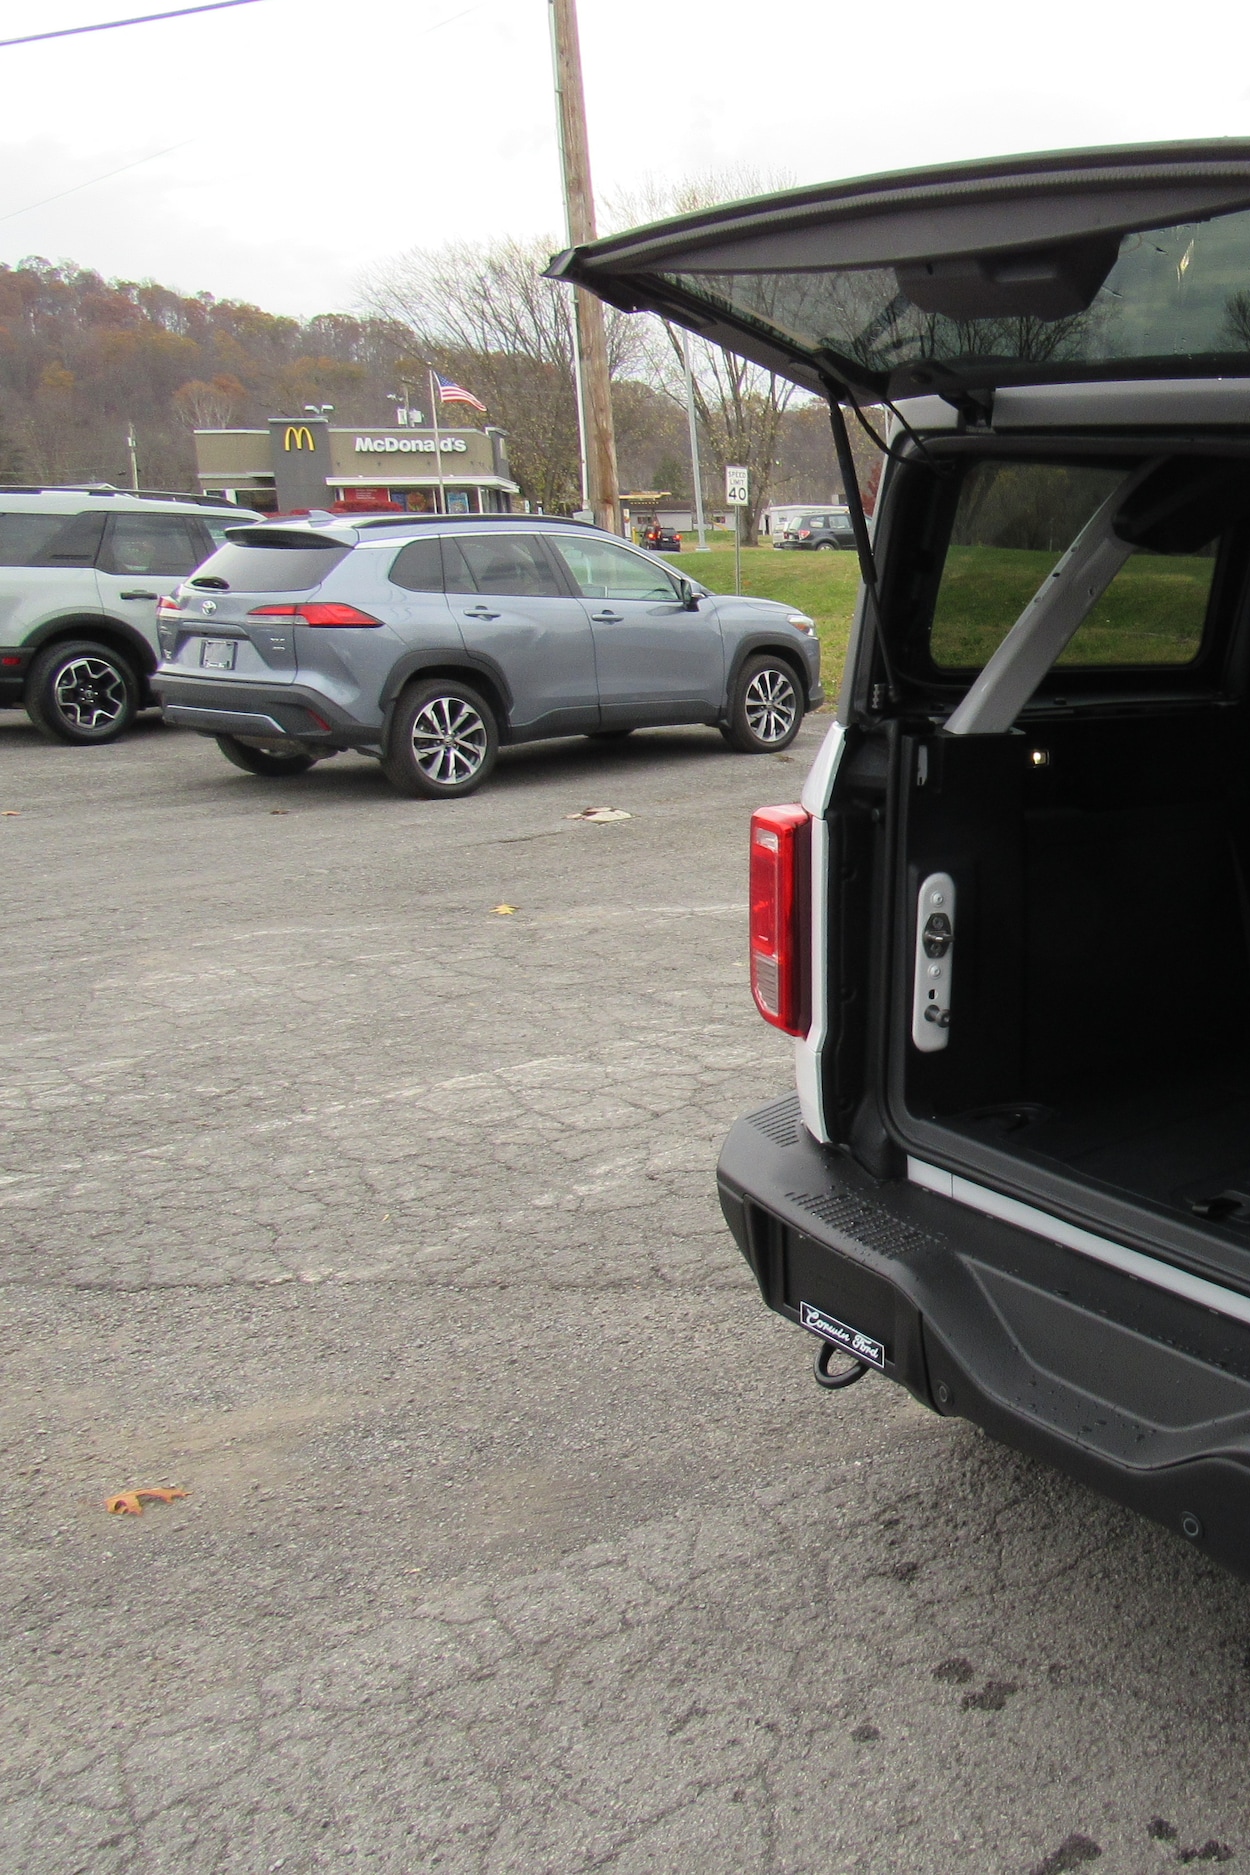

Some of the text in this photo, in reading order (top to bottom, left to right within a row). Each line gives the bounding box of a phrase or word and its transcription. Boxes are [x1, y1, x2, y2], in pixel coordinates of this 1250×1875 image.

[355, 436, 467, 452] McDonad's
[728, 471, 746, 479] SPEED
[728, 487, 746, 501] 40
[852, 1334, 879, 1358] Ford
